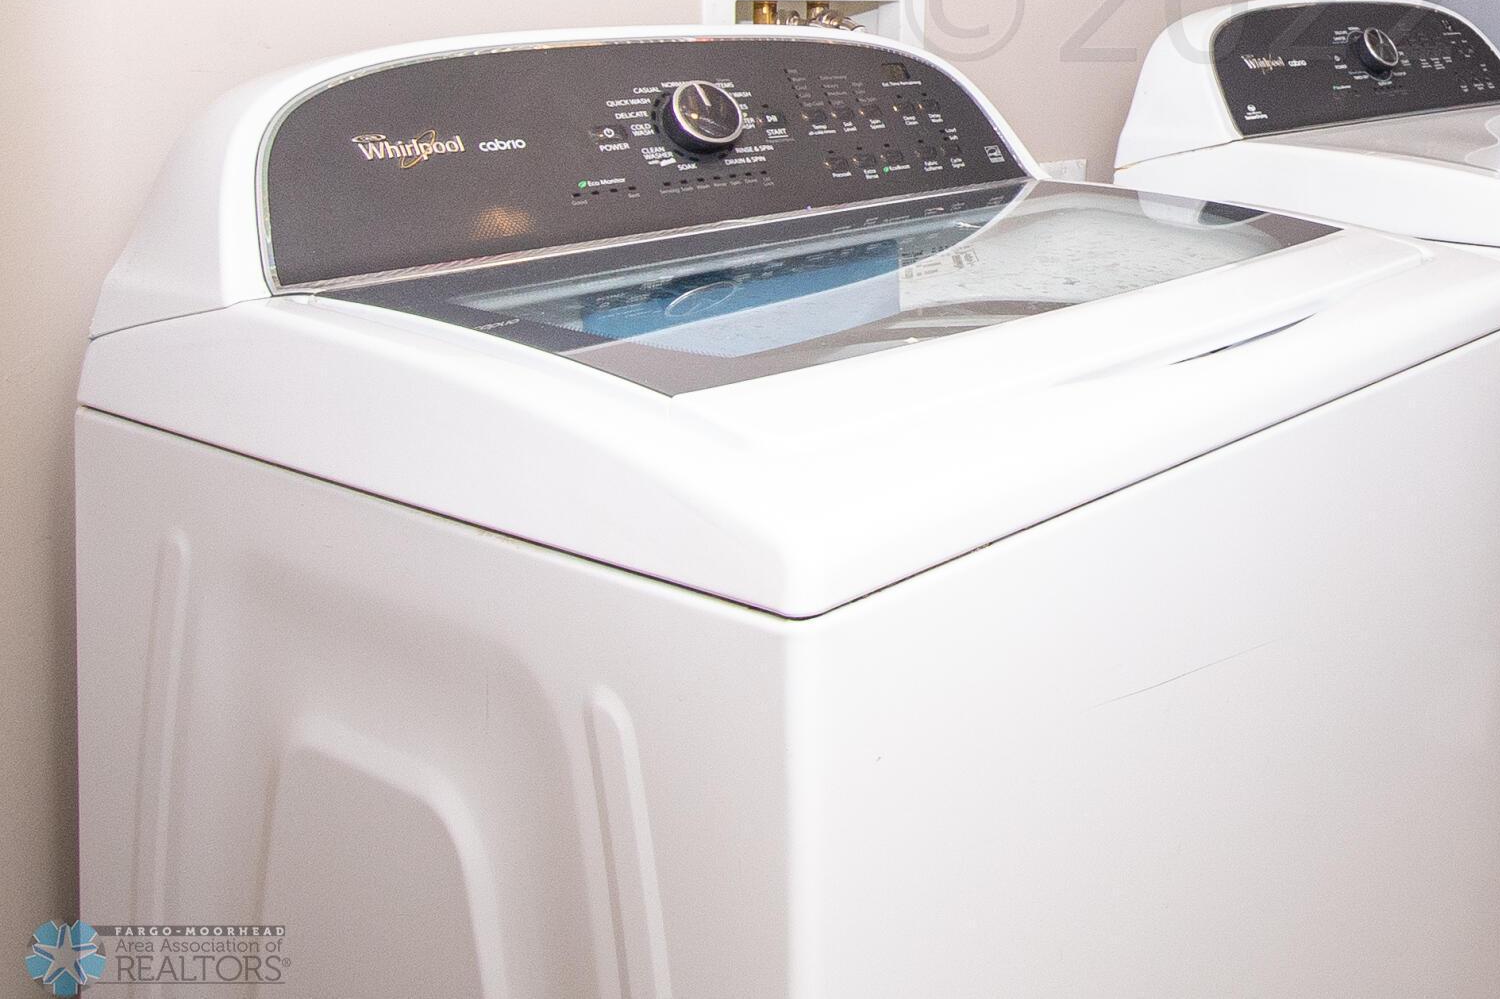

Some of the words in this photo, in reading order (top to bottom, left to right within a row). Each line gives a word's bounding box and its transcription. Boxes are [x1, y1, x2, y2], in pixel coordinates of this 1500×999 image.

[632, 86, 662, 94] CASUAL
[606, 99, 629, 107] QUICK
[614, 110, 648, 119] DELICATE
[630, 123, 651, 131] COLD
[766, 128, 787, 136] START
[352, 133, 466, 164] Whirlpool
[479, 138, 526, 152] cabrio
[599, 142, 630, 152] POWER
[641, 146, 666, 154] CLEAN
